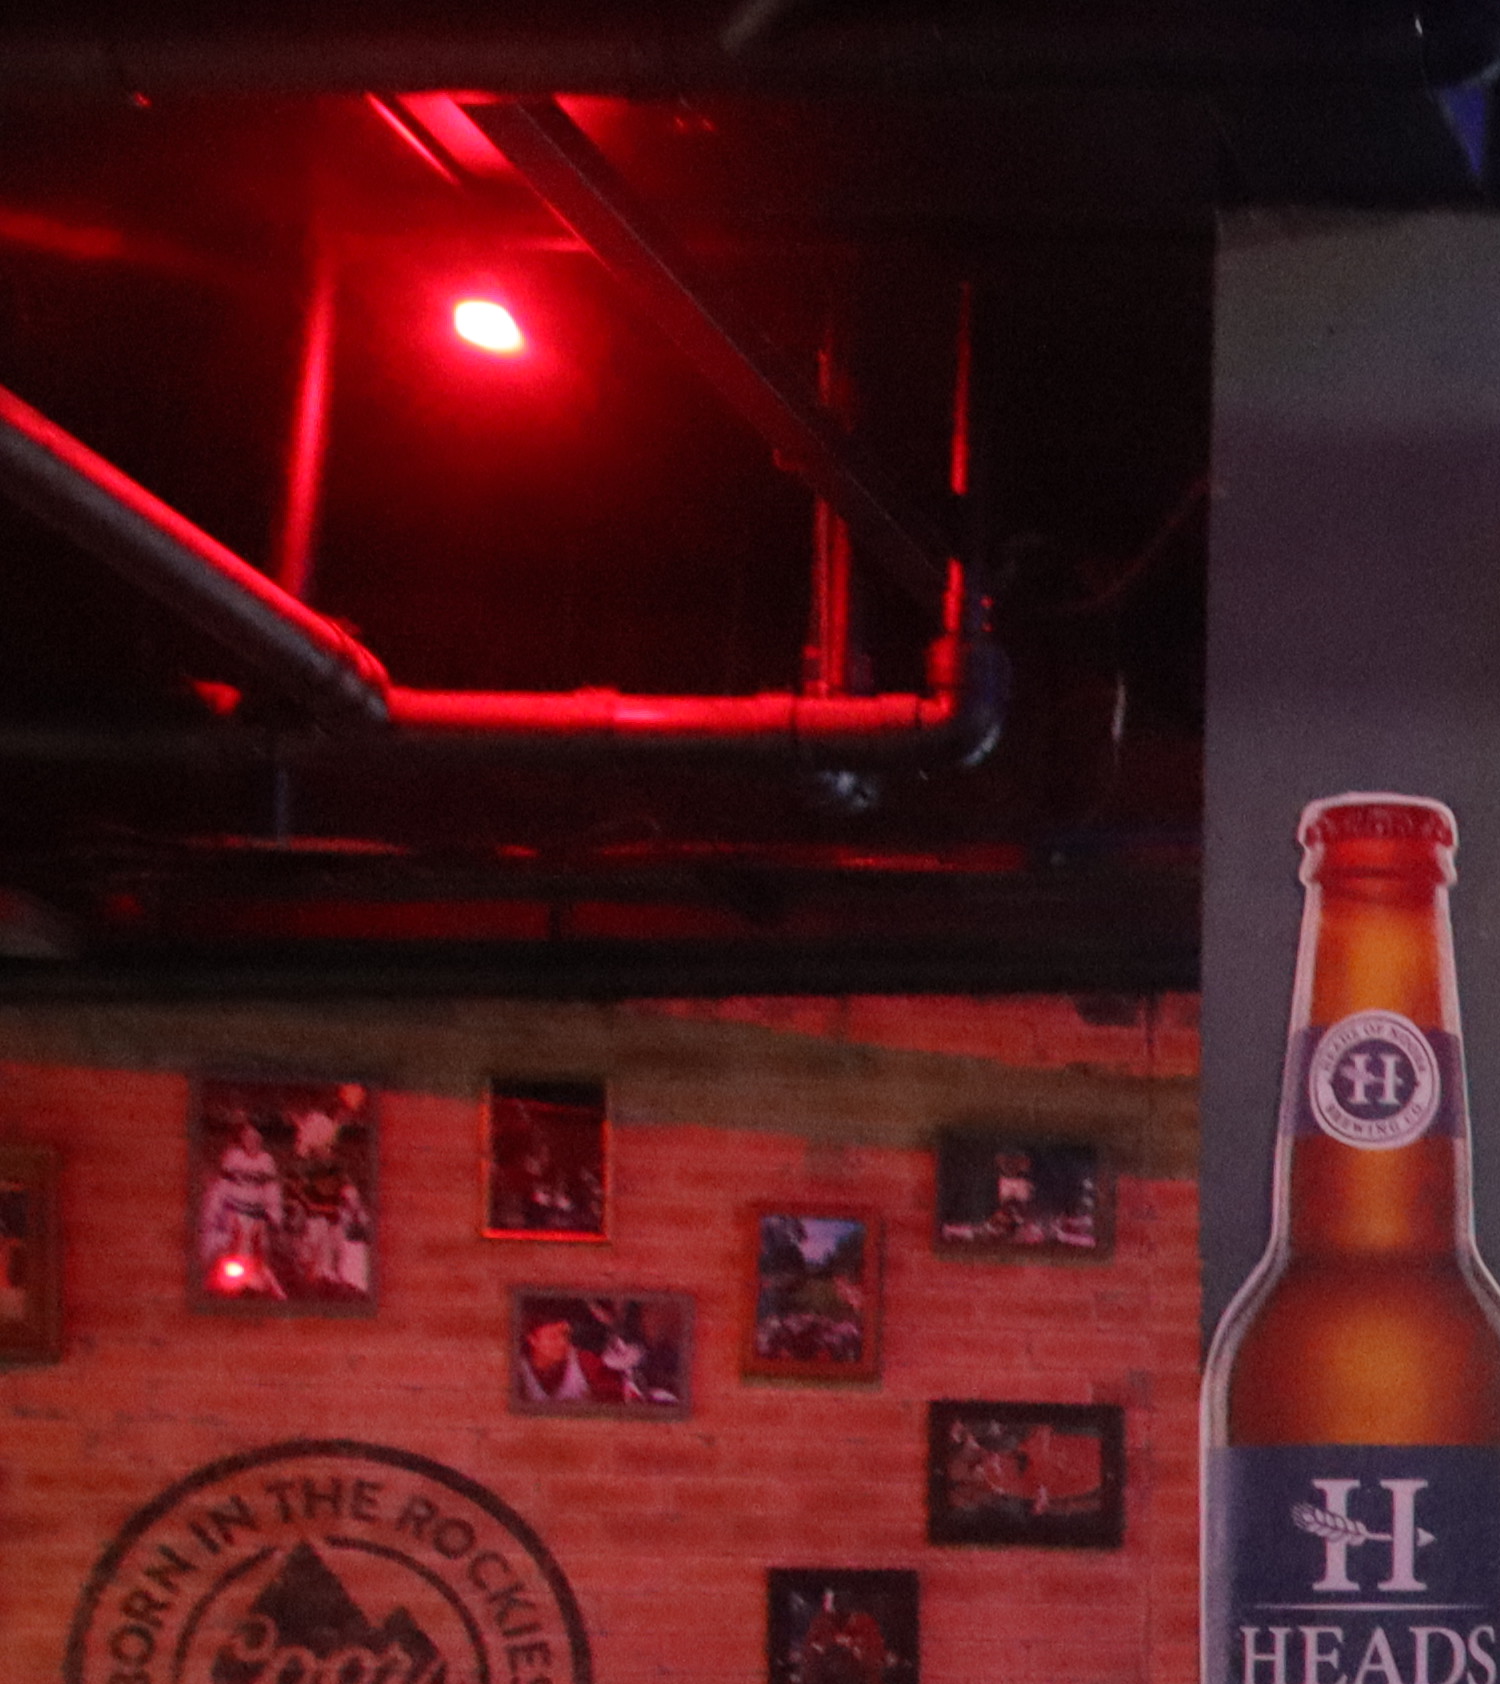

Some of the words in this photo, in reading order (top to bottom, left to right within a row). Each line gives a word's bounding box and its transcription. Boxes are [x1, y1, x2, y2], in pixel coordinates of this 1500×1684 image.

[189, 1492, 258, 1554] IN
[264, 1477, 384, 1526] THE
[1310, 1478, 1430, 1593] H
